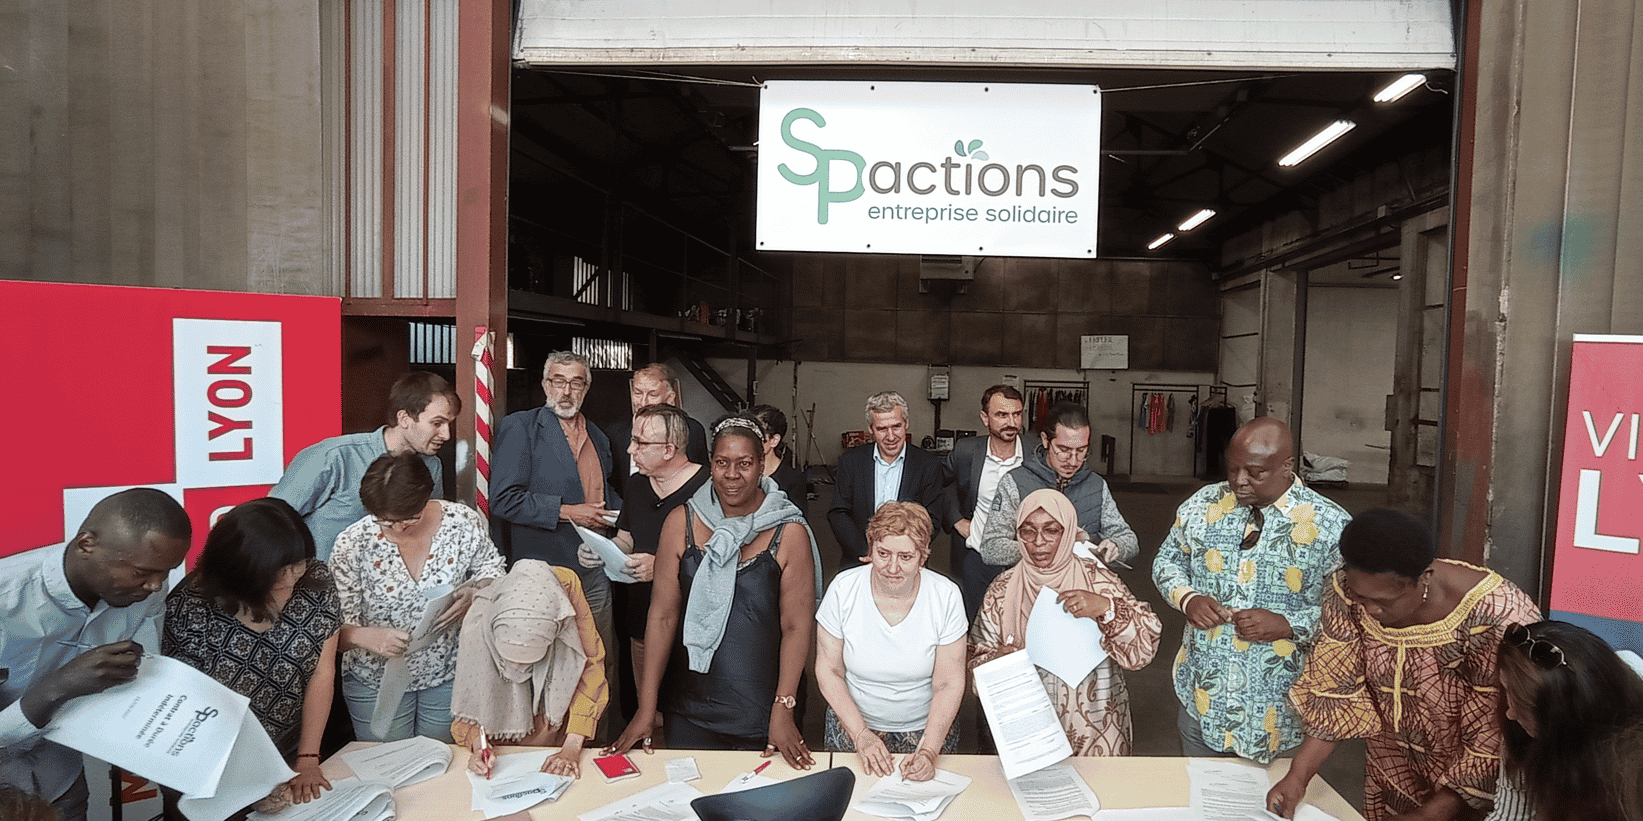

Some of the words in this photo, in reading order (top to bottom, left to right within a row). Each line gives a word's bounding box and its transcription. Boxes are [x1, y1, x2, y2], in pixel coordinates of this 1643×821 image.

[867, 204, 979, 224] entreprise
[985, 205, 1079, 224] solidaire
[206, 345, 254, 462] LYON
[1573, 467, 1643, 555] L
[135, 693, 174, 740] Indéterminée
[164, 694, 188, 721] Contrat
[143, 726, 165, 748] Durée
